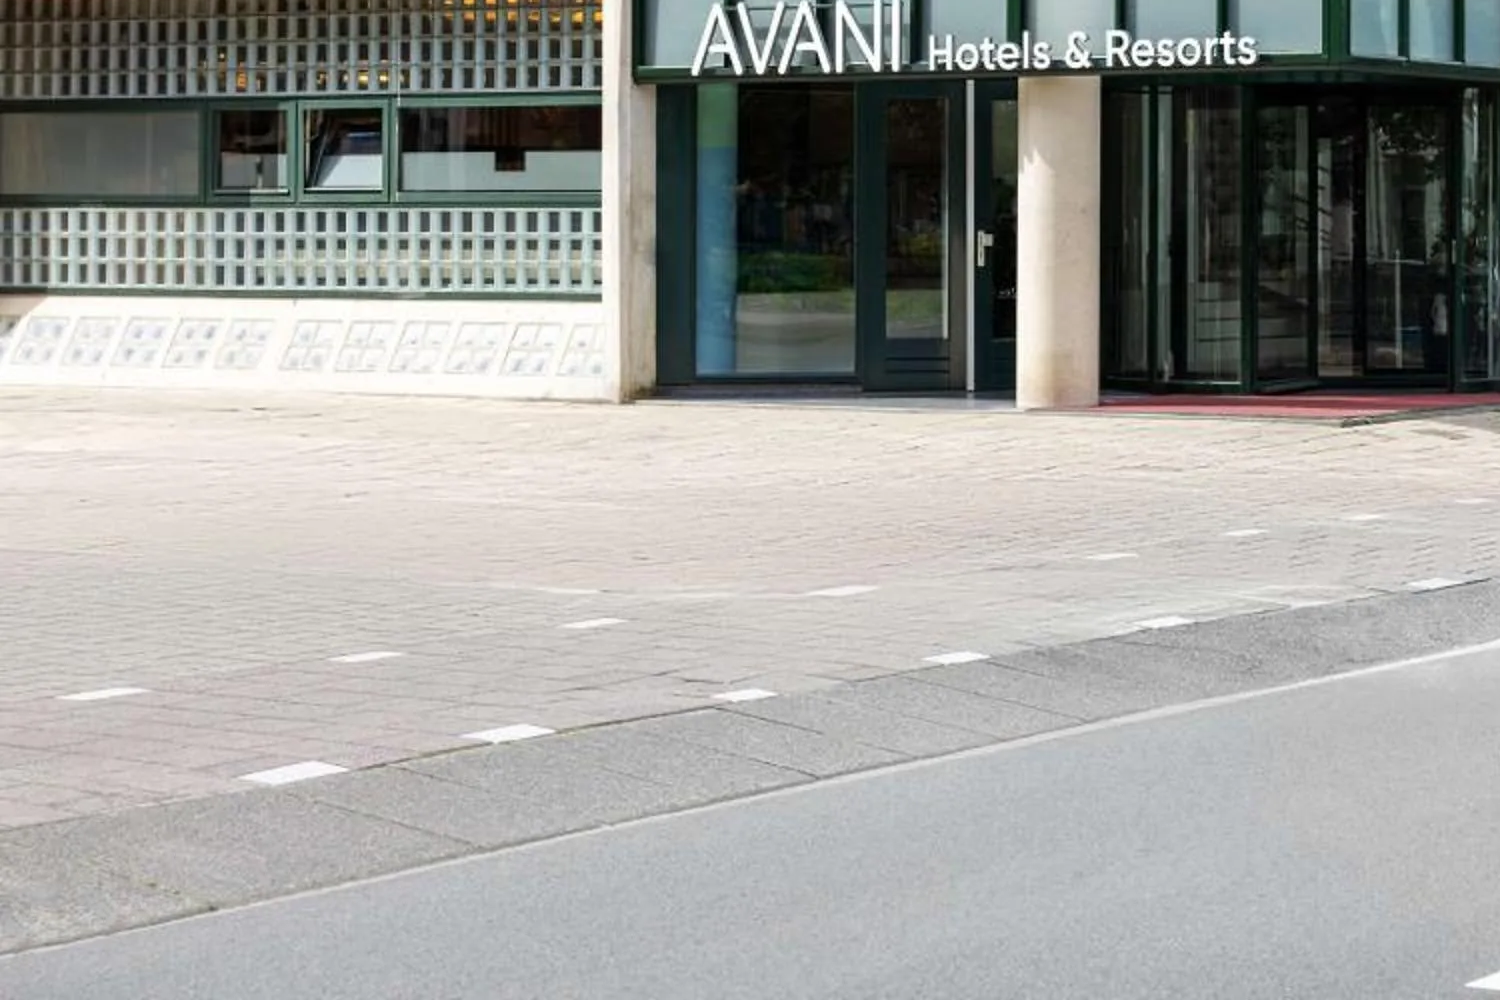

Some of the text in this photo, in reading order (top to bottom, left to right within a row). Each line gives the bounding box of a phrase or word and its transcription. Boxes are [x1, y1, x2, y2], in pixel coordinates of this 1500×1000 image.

[929, 31, 1051, 71] Hotels
[1063, 30, 1092, 68] &
[1104, 29, 1258, 67] Resorts
